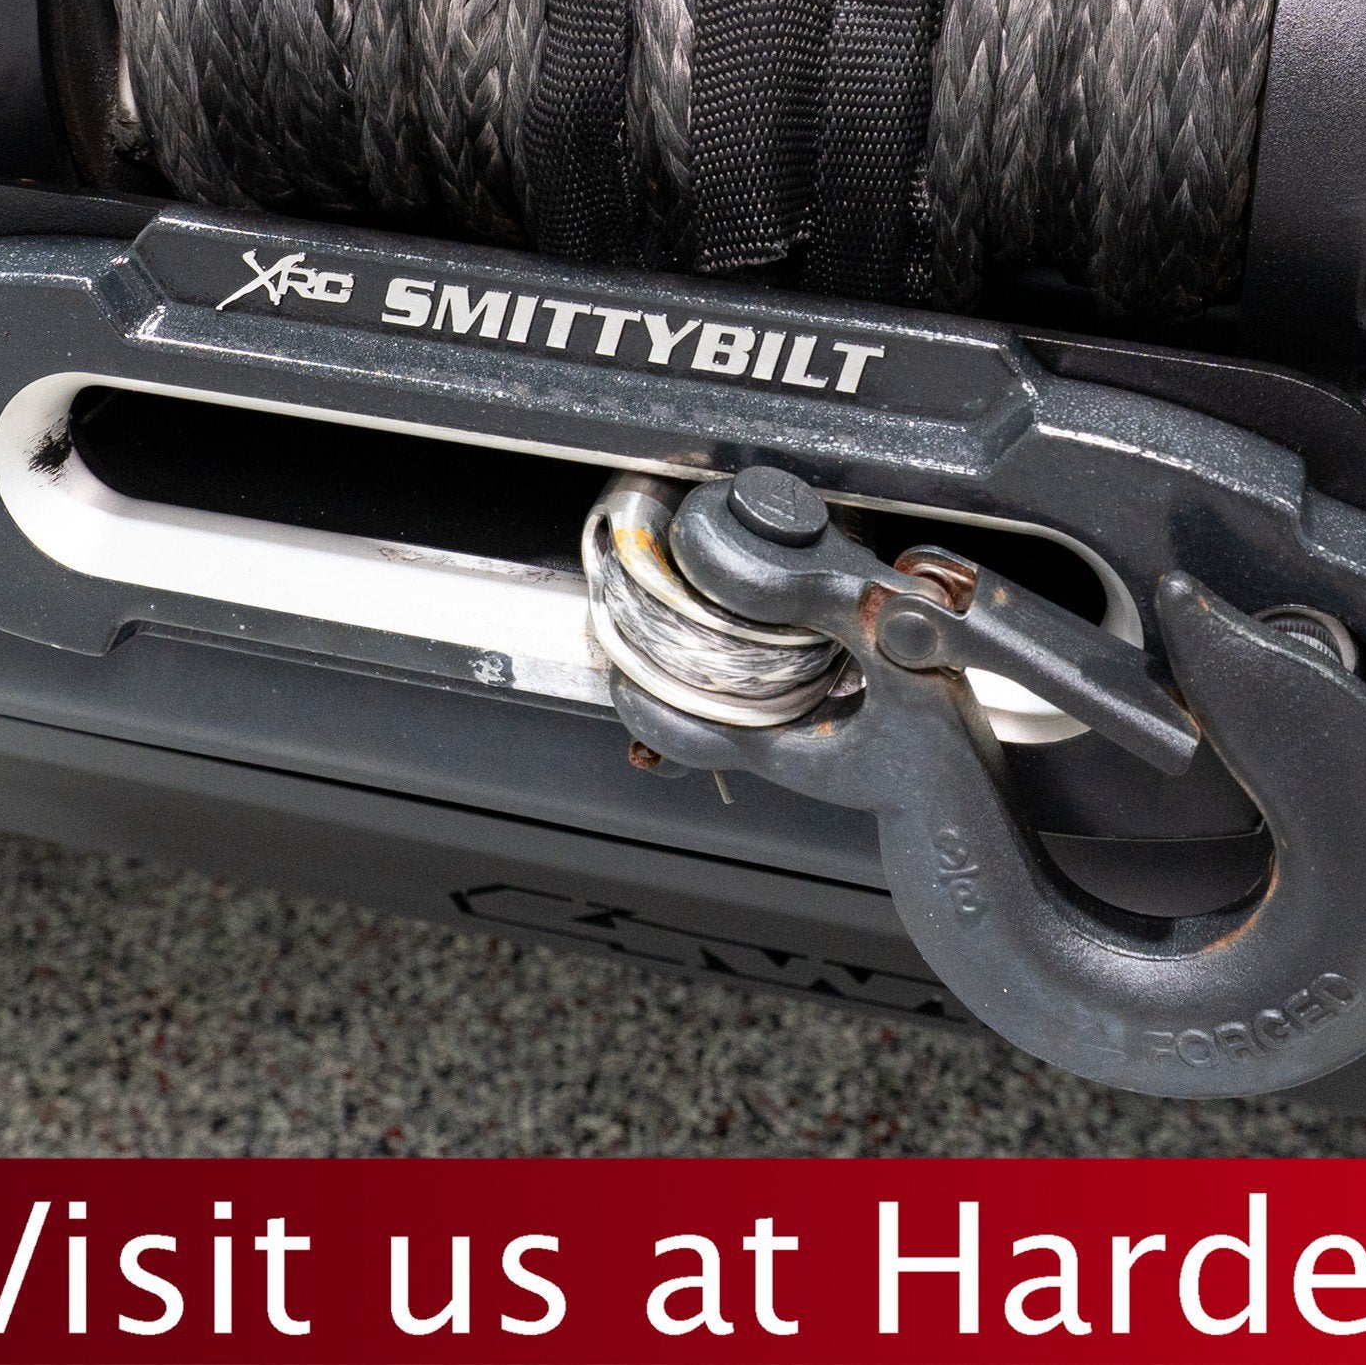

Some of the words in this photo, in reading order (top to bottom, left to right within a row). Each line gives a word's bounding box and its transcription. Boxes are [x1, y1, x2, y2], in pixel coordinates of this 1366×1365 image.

[216, 250, 354, 311] XRC
[381, 277, 885, 395] SMITTYBILT
[1143, 971, 1359, 1069] FORGED
